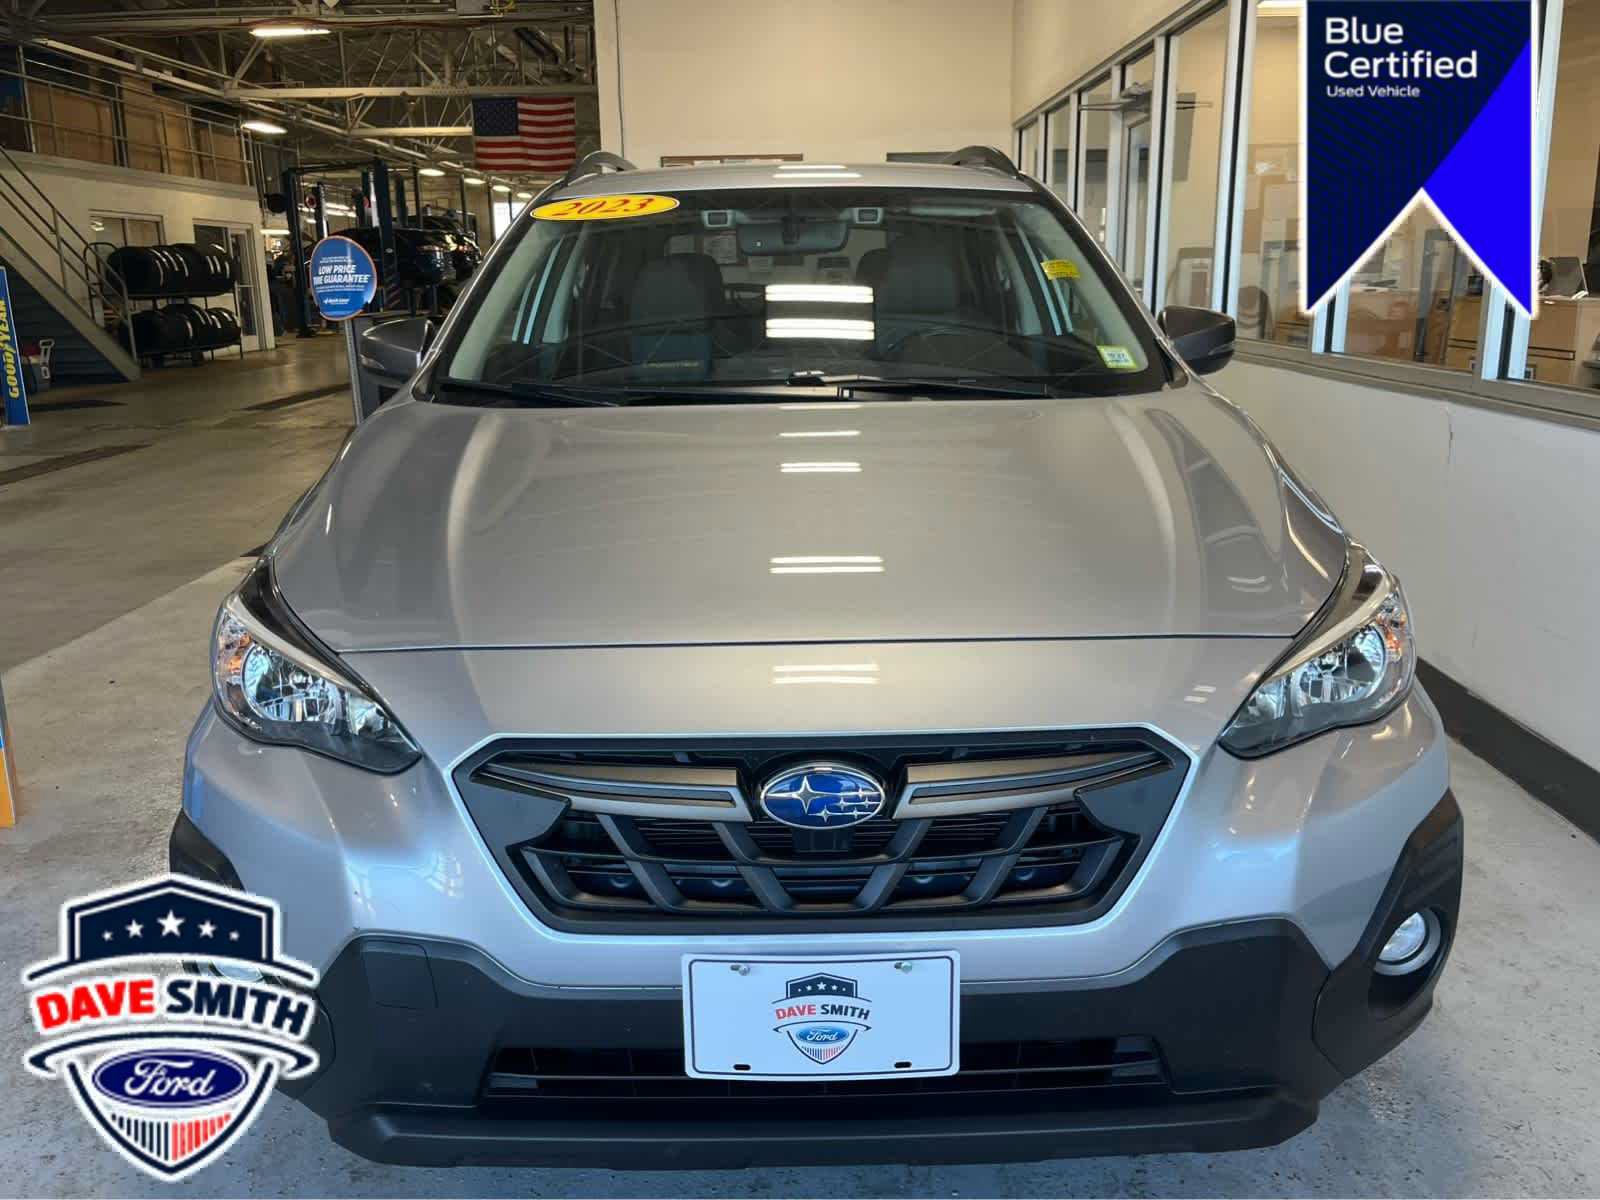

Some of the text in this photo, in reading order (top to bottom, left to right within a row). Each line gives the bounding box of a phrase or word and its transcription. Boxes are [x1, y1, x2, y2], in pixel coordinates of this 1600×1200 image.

[552, 198, 654, 216] 2023
[318, 265, 357, 275] LOW PRICE
[323, 274, 369, 284] GUARANTEE
[0, 299, 19, 399] GOODYEAR
[775, 1004, 870, 1020] DAVE SMITH
[806, 1029, 838, 1041] Ford
